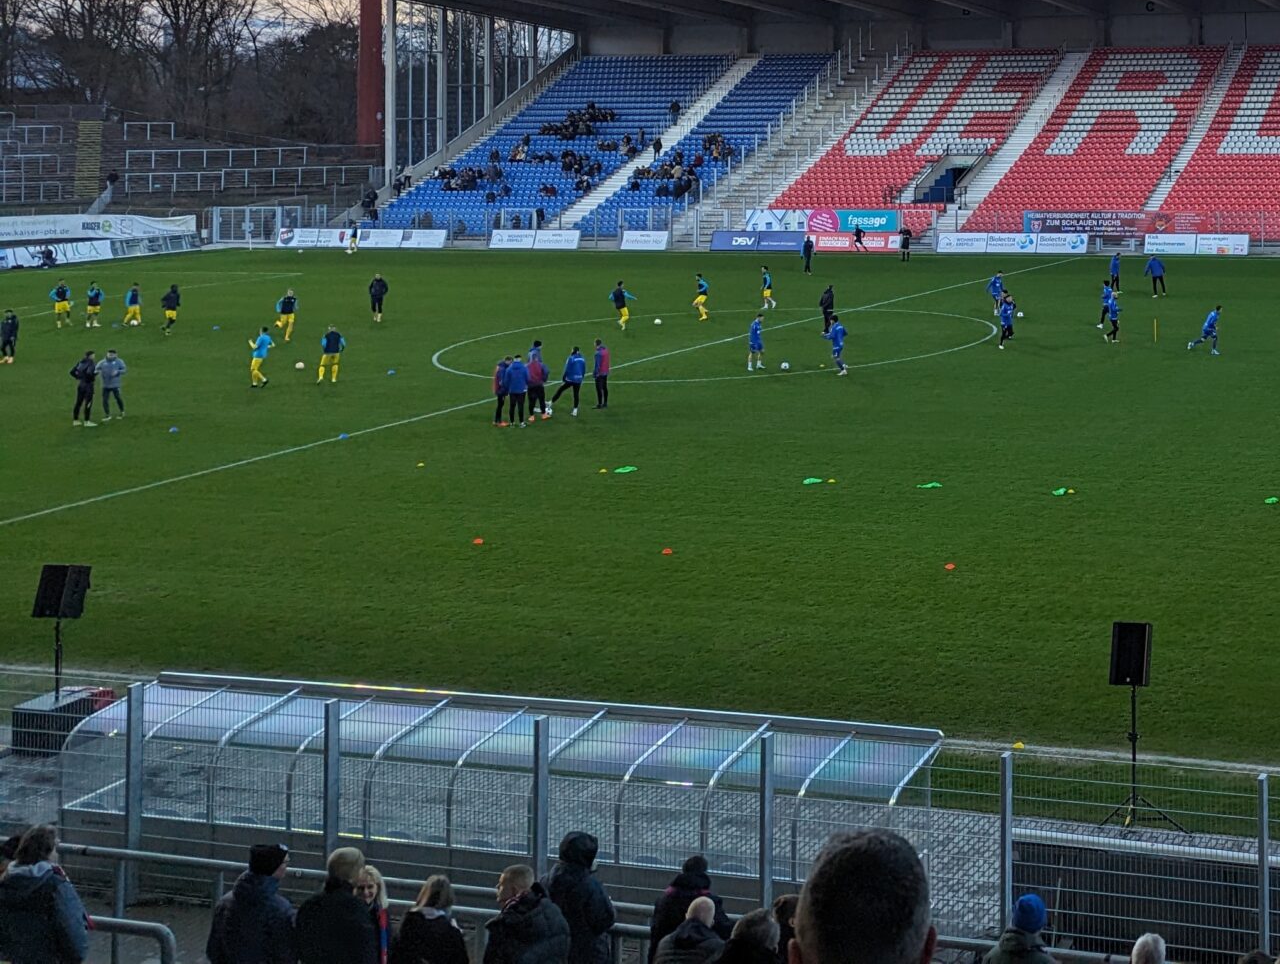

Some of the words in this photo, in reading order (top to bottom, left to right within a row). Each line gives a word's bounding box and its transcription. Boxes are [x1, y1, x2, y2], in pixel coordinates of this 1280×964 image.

[1146, 2, 1155, 12] C
[848, 214, 886, 227] fassago
[732, 236, 755, 245] DSV
